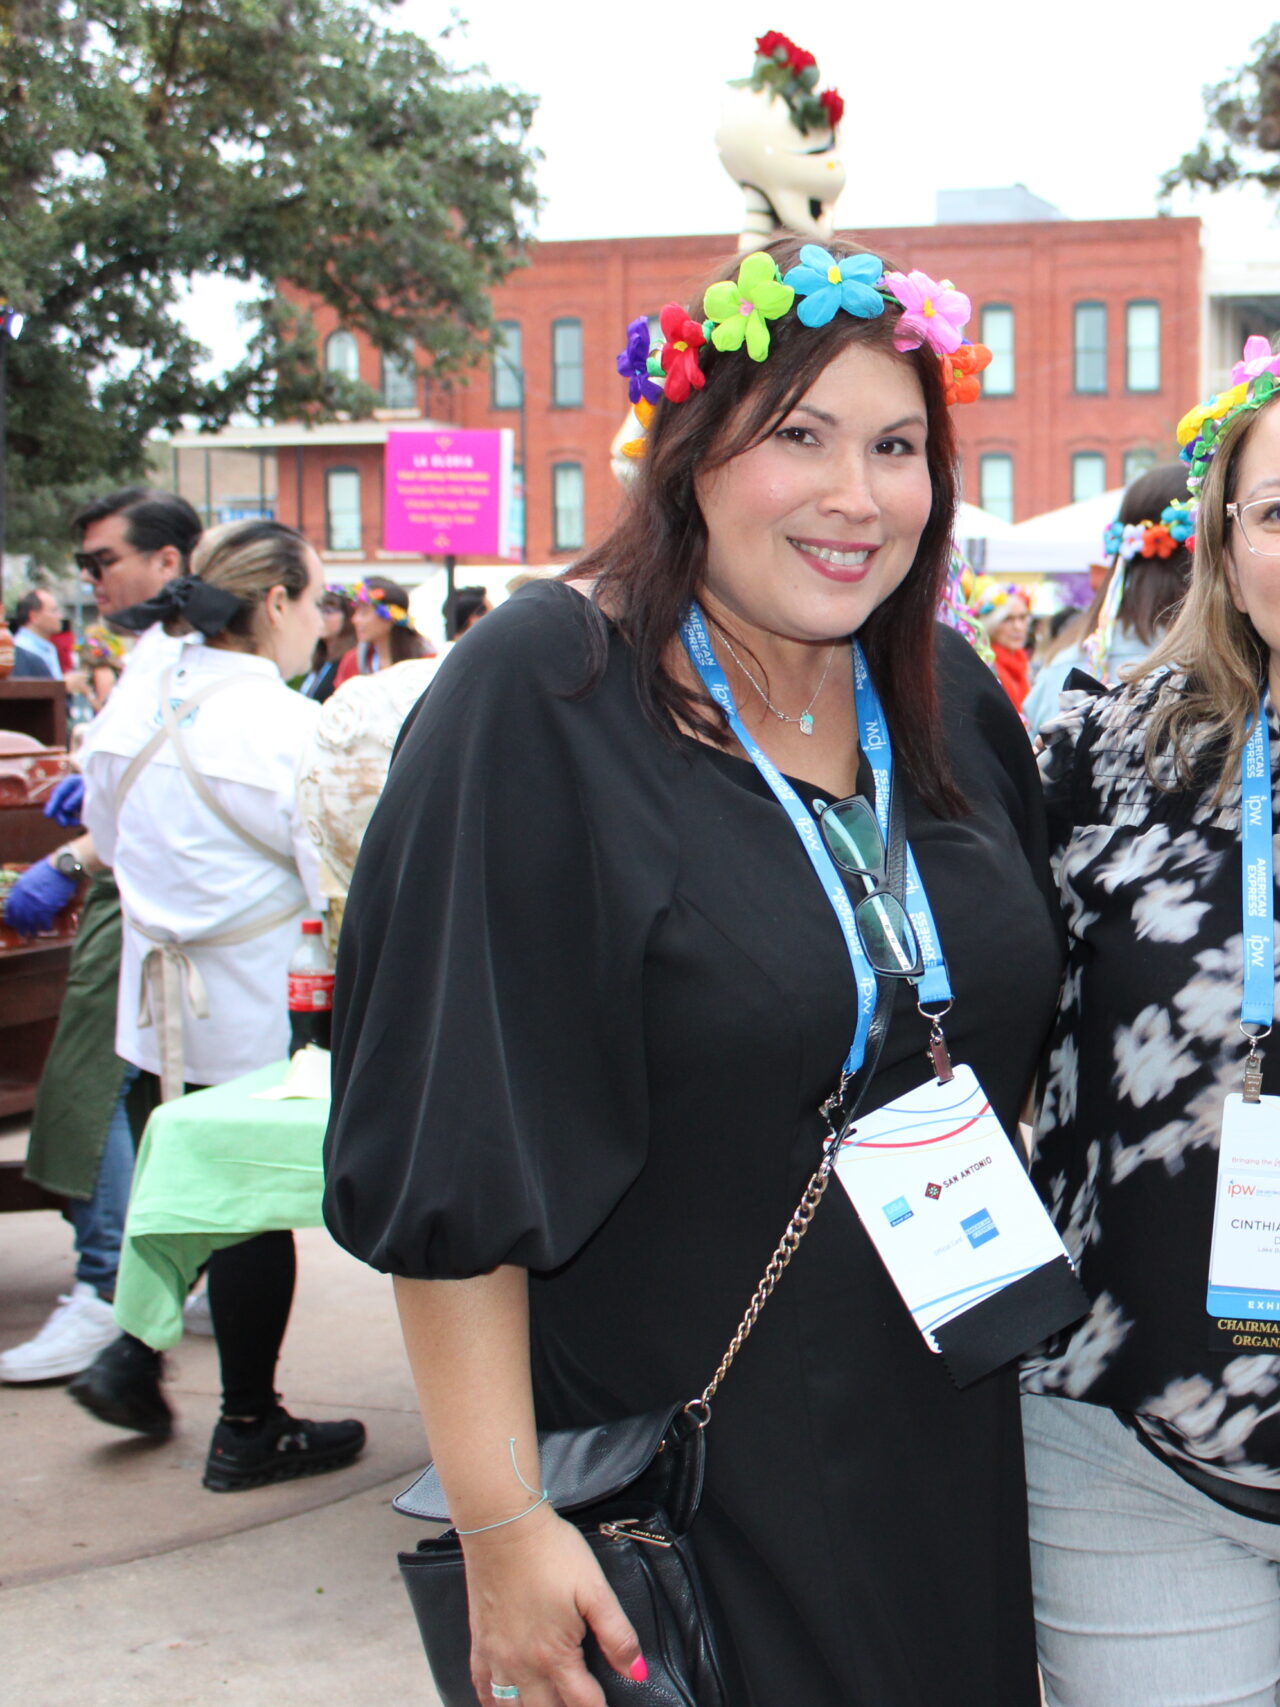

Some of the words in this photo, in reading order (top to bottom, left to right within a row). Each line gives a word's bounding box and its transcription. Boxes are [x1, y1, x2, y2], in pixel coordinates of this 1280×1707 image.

[712, 683, 736, 716] ipw
[863, 721, 887, 751] ipw
[1247, 734, 1256, 779] XPRESS
[1245, 795, 1268, 826] ipw
[797, 817, 820, 851] ipw
[1247, 864, 1257, 917] EXPRESS
[1256, 858, 1267, 917] AMERICAN
[1247, 935, 1270, 968] ipw
[860, 978, 876, 1014] ipw
[942, 1173, 960, 1189] SAN
[960, 1156, 993, 1181] ANTONIO
[1228, 1179, 1257, 1198] ipw
